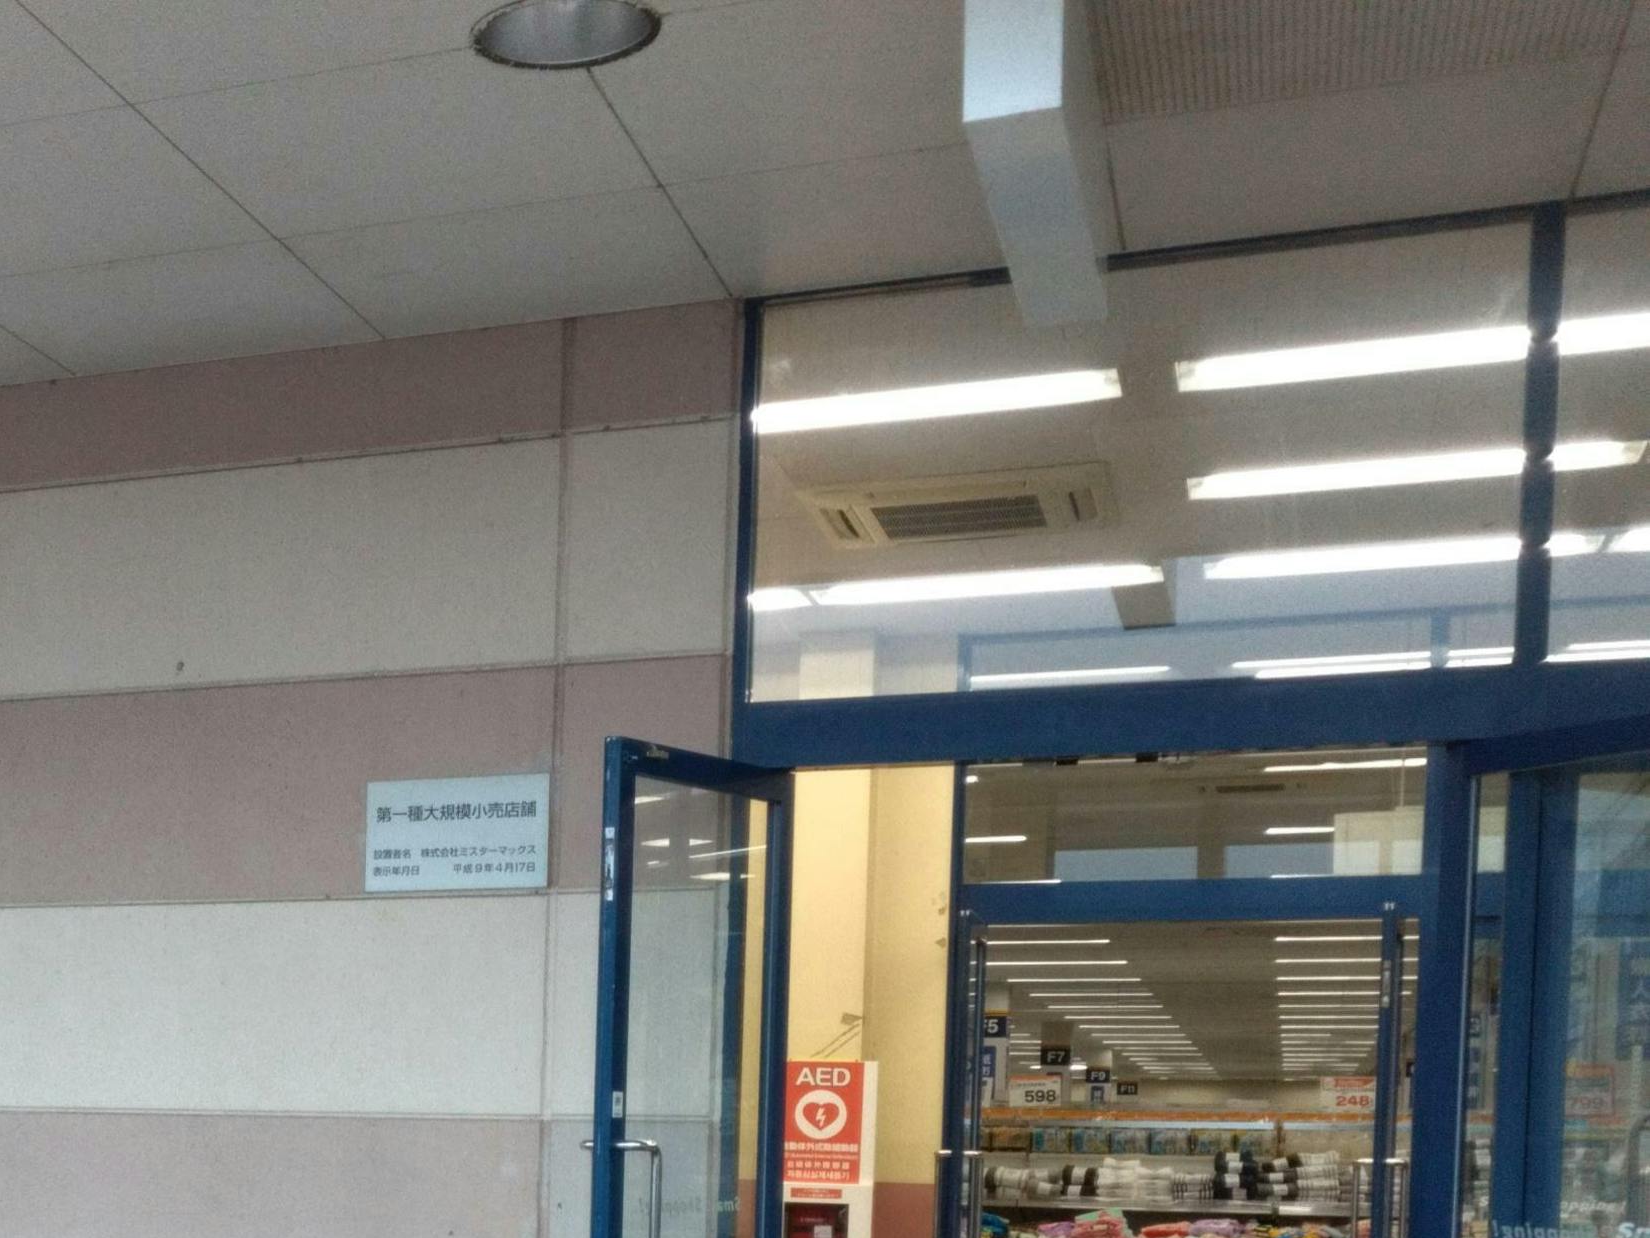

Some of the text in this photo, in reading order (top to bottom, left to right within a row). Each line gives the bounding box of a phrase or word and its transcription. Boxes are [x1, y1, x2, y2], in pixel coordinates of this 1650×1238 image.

[376, 801, 537, 823] 第一種大規模小売店舗
[421, 845, 537, 859] 株式会社ミスターマックス
[1046, 1050, 1066, 1063] F7
[795, 1067, 851, 1086] AED
[1090, 1070, 1107, 1081] F9
[1024, 1089, 1057, 1103] 598
[1335, 1095, 1370, 1107] 248
